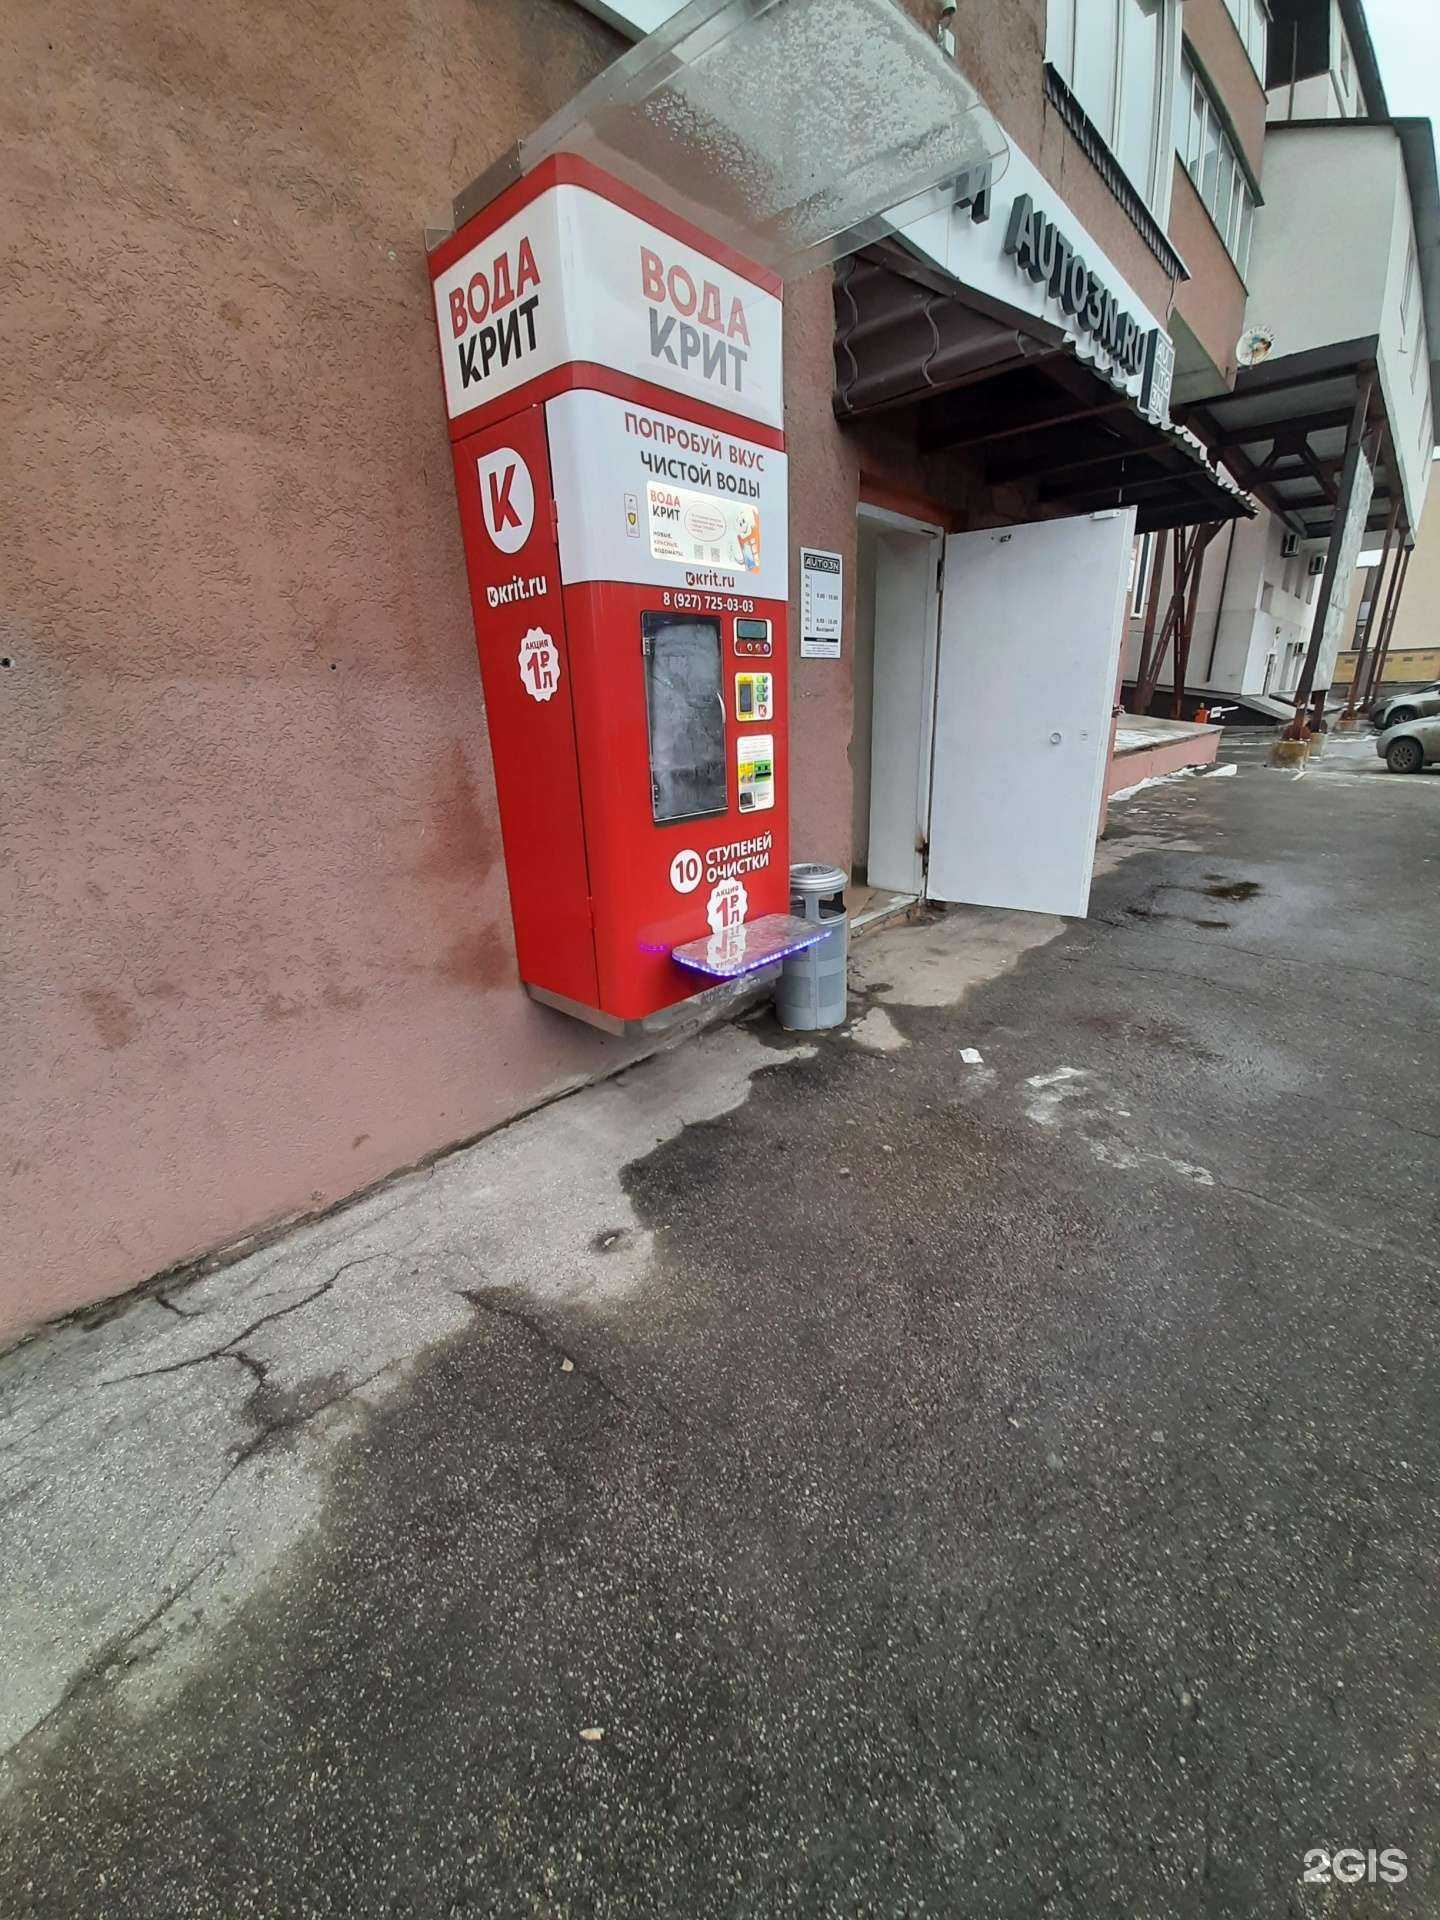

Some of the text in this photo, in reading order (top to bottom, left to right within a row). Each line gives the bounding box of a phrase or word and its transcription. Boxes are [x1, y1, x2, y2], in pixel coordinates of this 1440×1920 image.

[449, 236, 541, 339] ВОДА
[640, 246, 750, 347] ВОДА
[1004, 193, 1149, 377] AUTO3N.RU
[458, 296, 539, 389] КРИТ
[649, 307, 748, 392] КРИТ
[625, 412, 764, 472] ПОПРОБУЙ ВКУС
[640, 451, 760, 499] ЧИСТОЙ ВОДЫ
[650, 490, 681, 507] ВОДА
[652, 504, 680, 521] КРИТ
[663, 592, 754, 613] 8 (927) 725-03-03
[525, 639, 549, 651] АКЦИЯ
[675, 853, 769, 884] 10 ОЧИСТКИ
[705, 831, 772, 865] СТУПЕНЕЙ
[716, 885, 739, 897] АКЦИЯ
